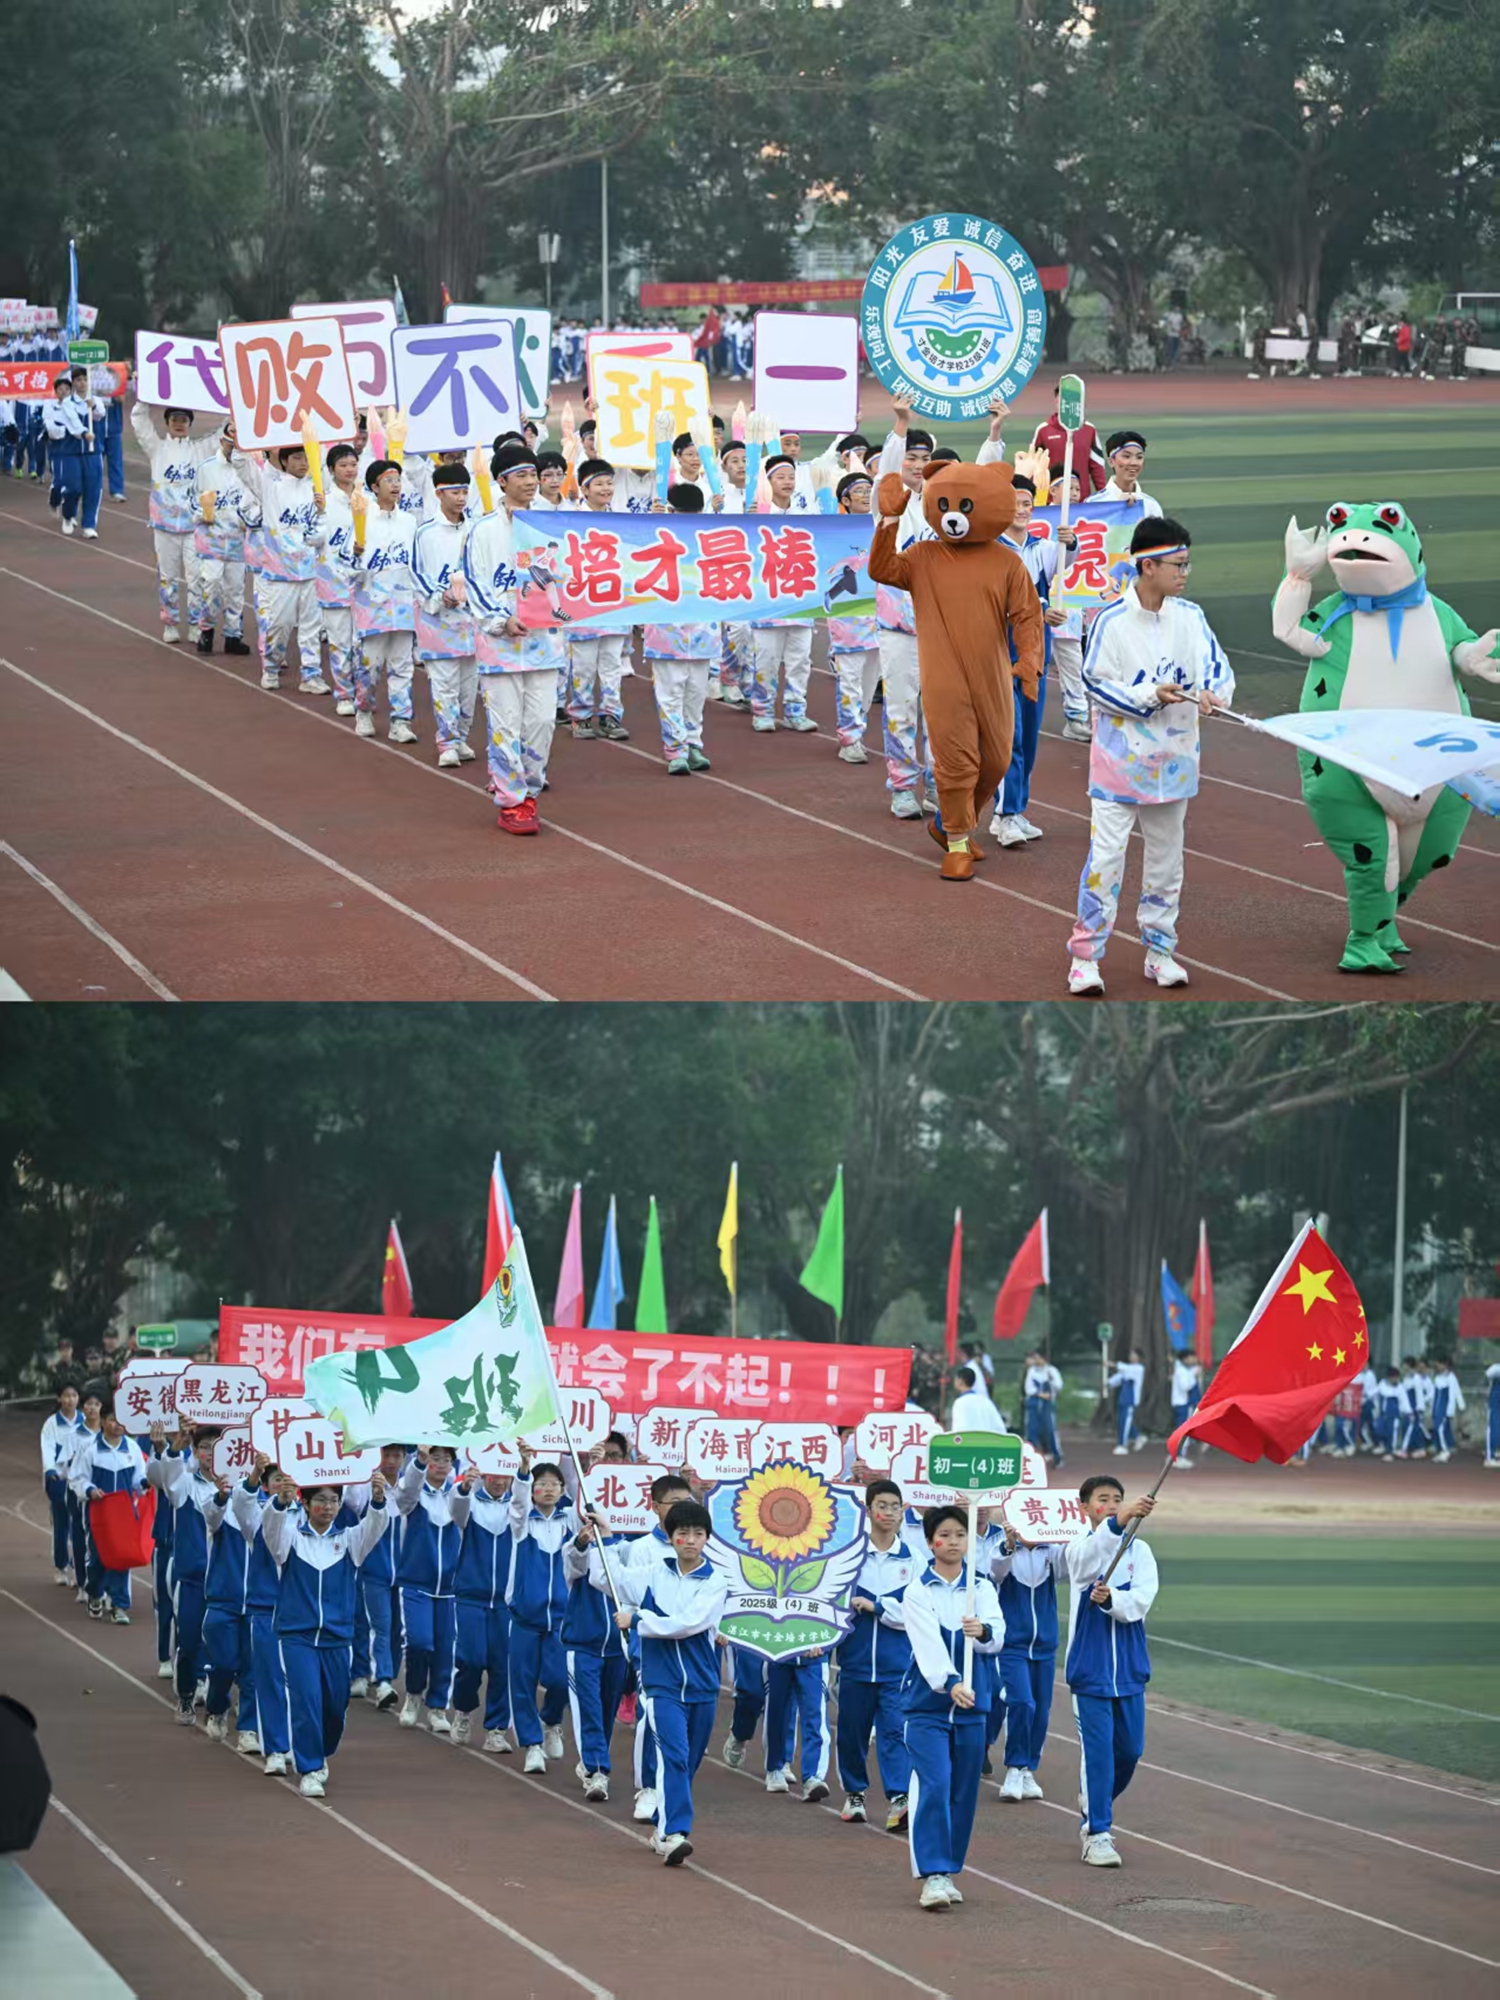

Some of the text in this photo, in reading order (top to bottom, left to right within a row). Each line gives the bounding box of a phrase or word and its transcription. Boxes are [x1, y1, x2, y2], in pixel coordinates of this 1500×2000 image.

[870, 217, 1037, 294] 阳光 友爱 诚信 奋进
[865, 305, 892, 376] 乐观向上
[1014, 309, 1042, 377] 勤学善思
[917, 337, 991, 371] 寸金培才学校25级1班
[146, 341, 230, 408] 代
[235, 331, 343, 438] 败
[406, 334, 509, 436] 不
[765, 365, 847, 380] 一
[604, 370, 697, 459] 班
[565, 526, 817, 603] 培才最棒
[180, 1379, 261, 1405] 黑龙江
[189, 1408, 250, 1420] Heilongjiang
[765, 1434, 828, 1465] 江西
[869, 1423, 928, 1452] 河北
[226, 1438, 254, 1467] 浙
[933, 1456, 1015, 1476] 初一(4)班
[314, 1466, 350, 1478] Shanxi
[715, 1465, 748, 1474] Hainan
[610, 1515, 646, 1526] Beijing
[1020, 1497, 1087, 1526] 贵州
[1037, 1528, 1079, 1536] Guizhou
[727, 1623, 832, 1643] 湛江市寸金培才学校
